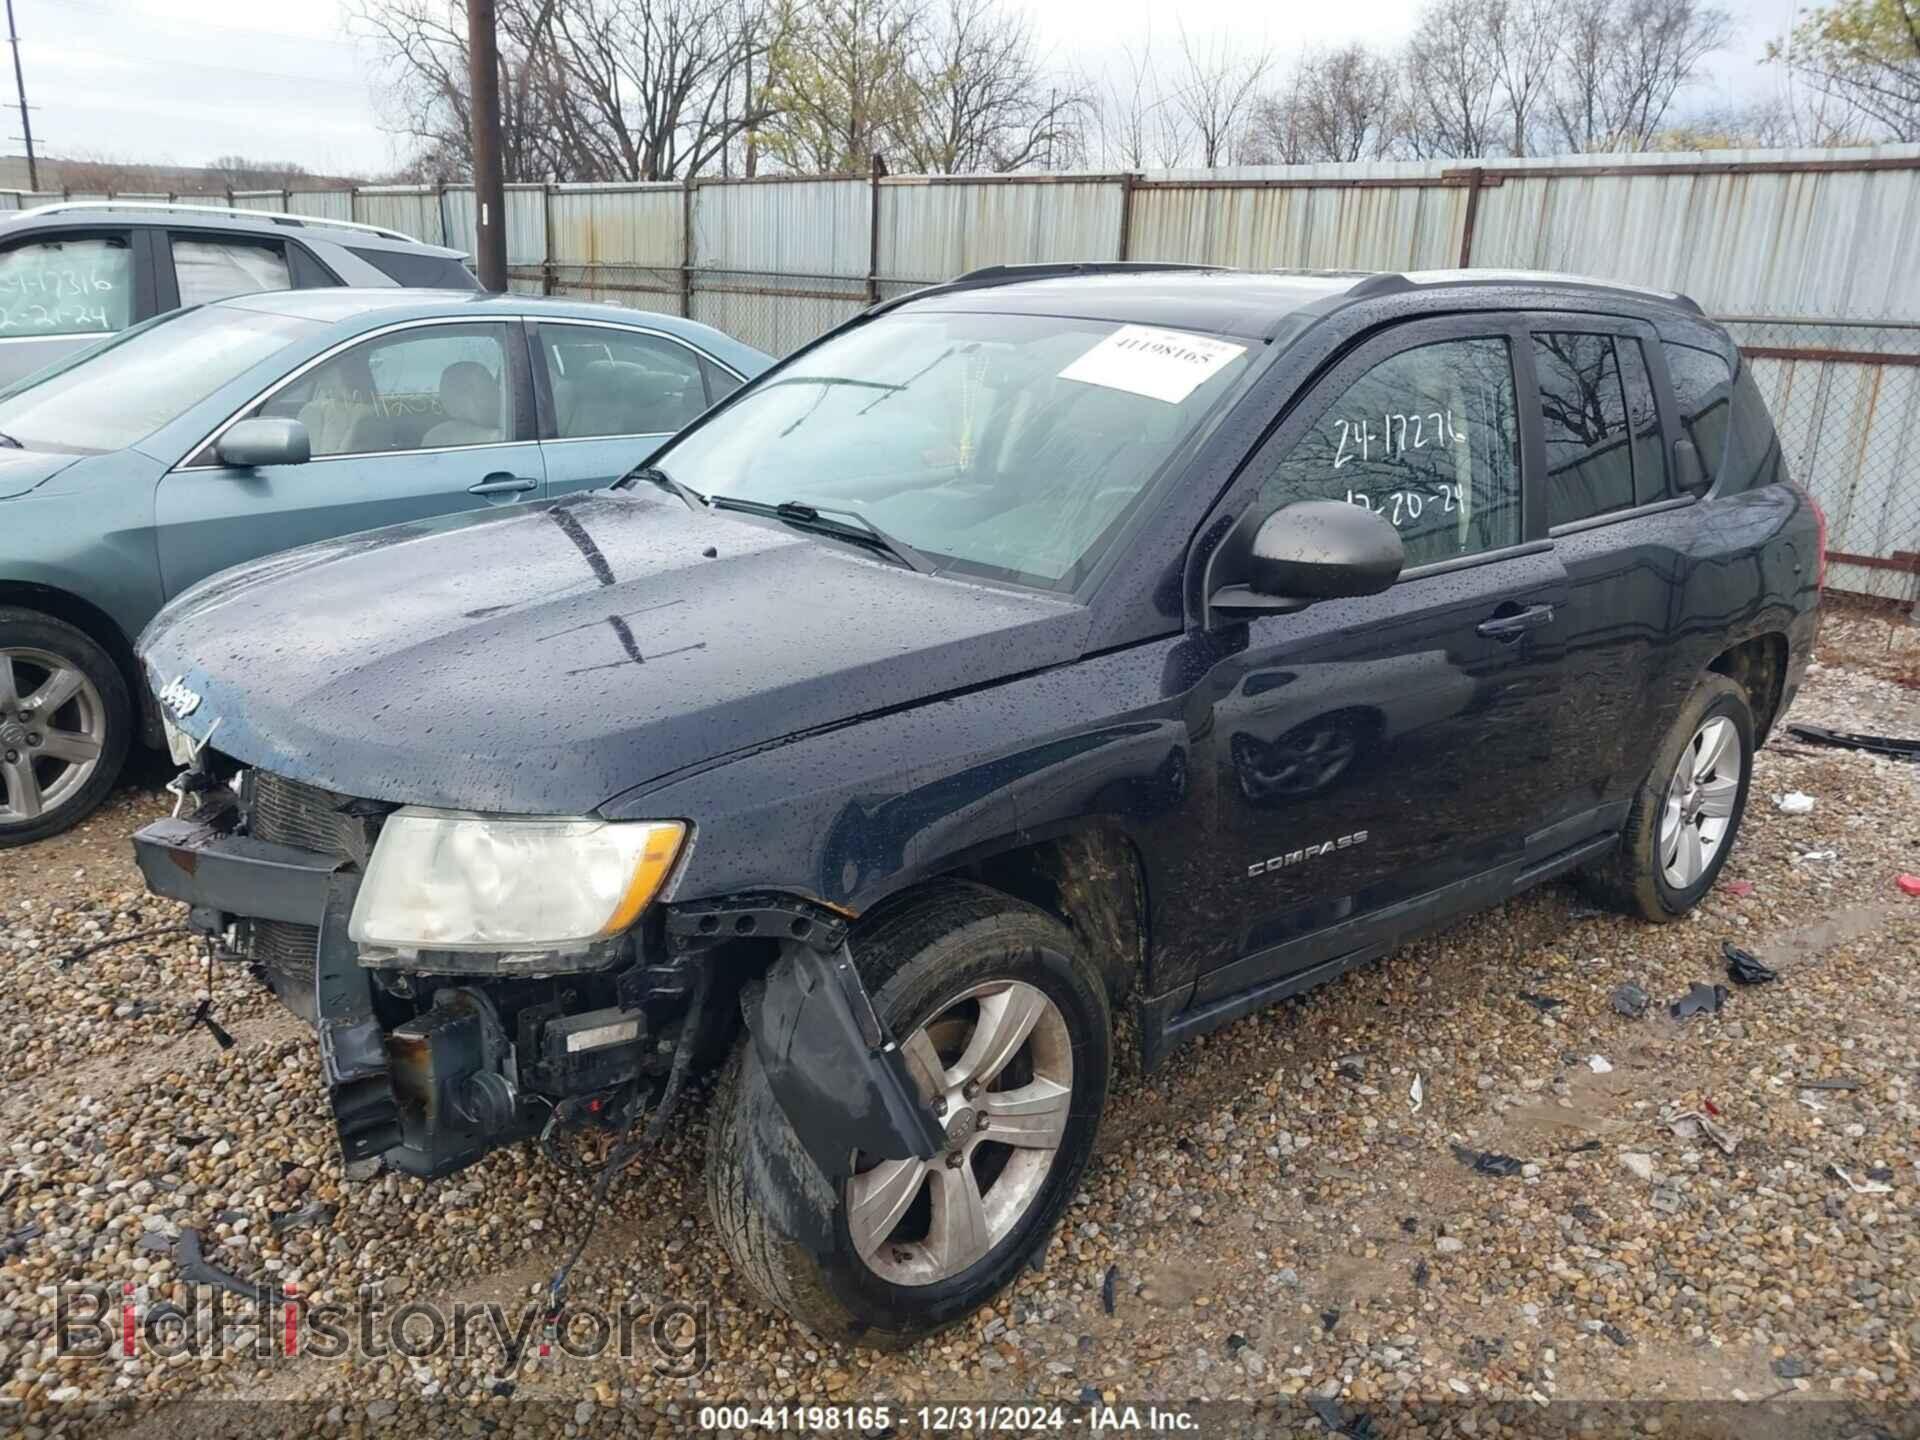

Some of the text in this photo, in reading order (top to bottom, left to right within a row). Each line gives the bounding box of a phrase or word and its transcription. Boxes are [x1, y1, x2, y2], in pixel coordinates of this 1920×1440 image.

[1115, 337, 1217, 364] 41198165
[160, 675, 202, 718] Jeep
[1247, 830, 1369, 878] COMPASS
